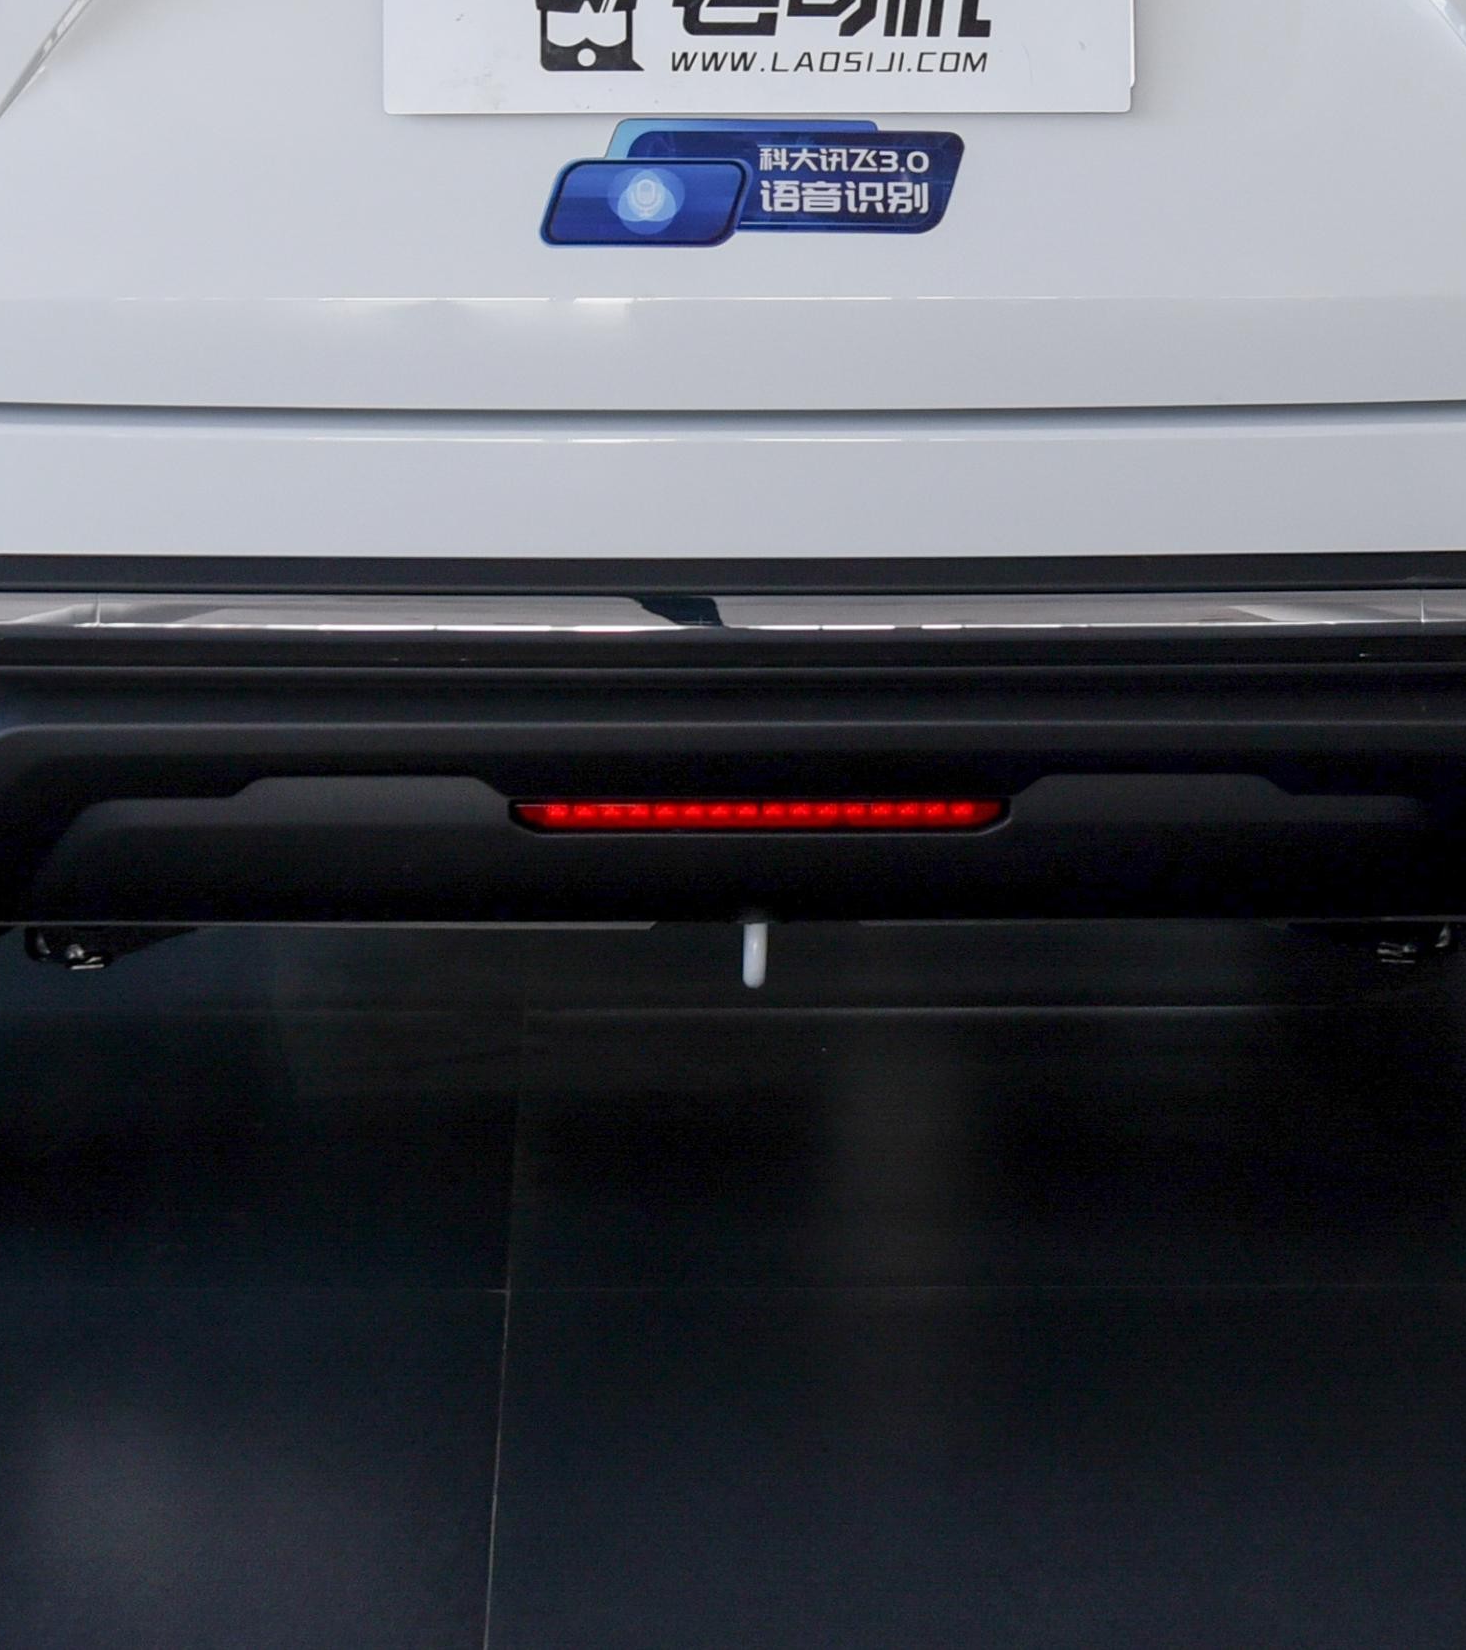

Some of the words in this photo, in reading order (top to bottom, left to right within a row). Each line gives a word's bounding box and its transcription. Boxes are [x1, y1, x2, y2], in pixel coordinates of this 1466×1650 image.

[670, 51, 989, 74] WWW.LAOSIJI.COM
[758, 147, 930, 174] 科大讯飞3.0
[759, 180, 930, 216] 语音识别
